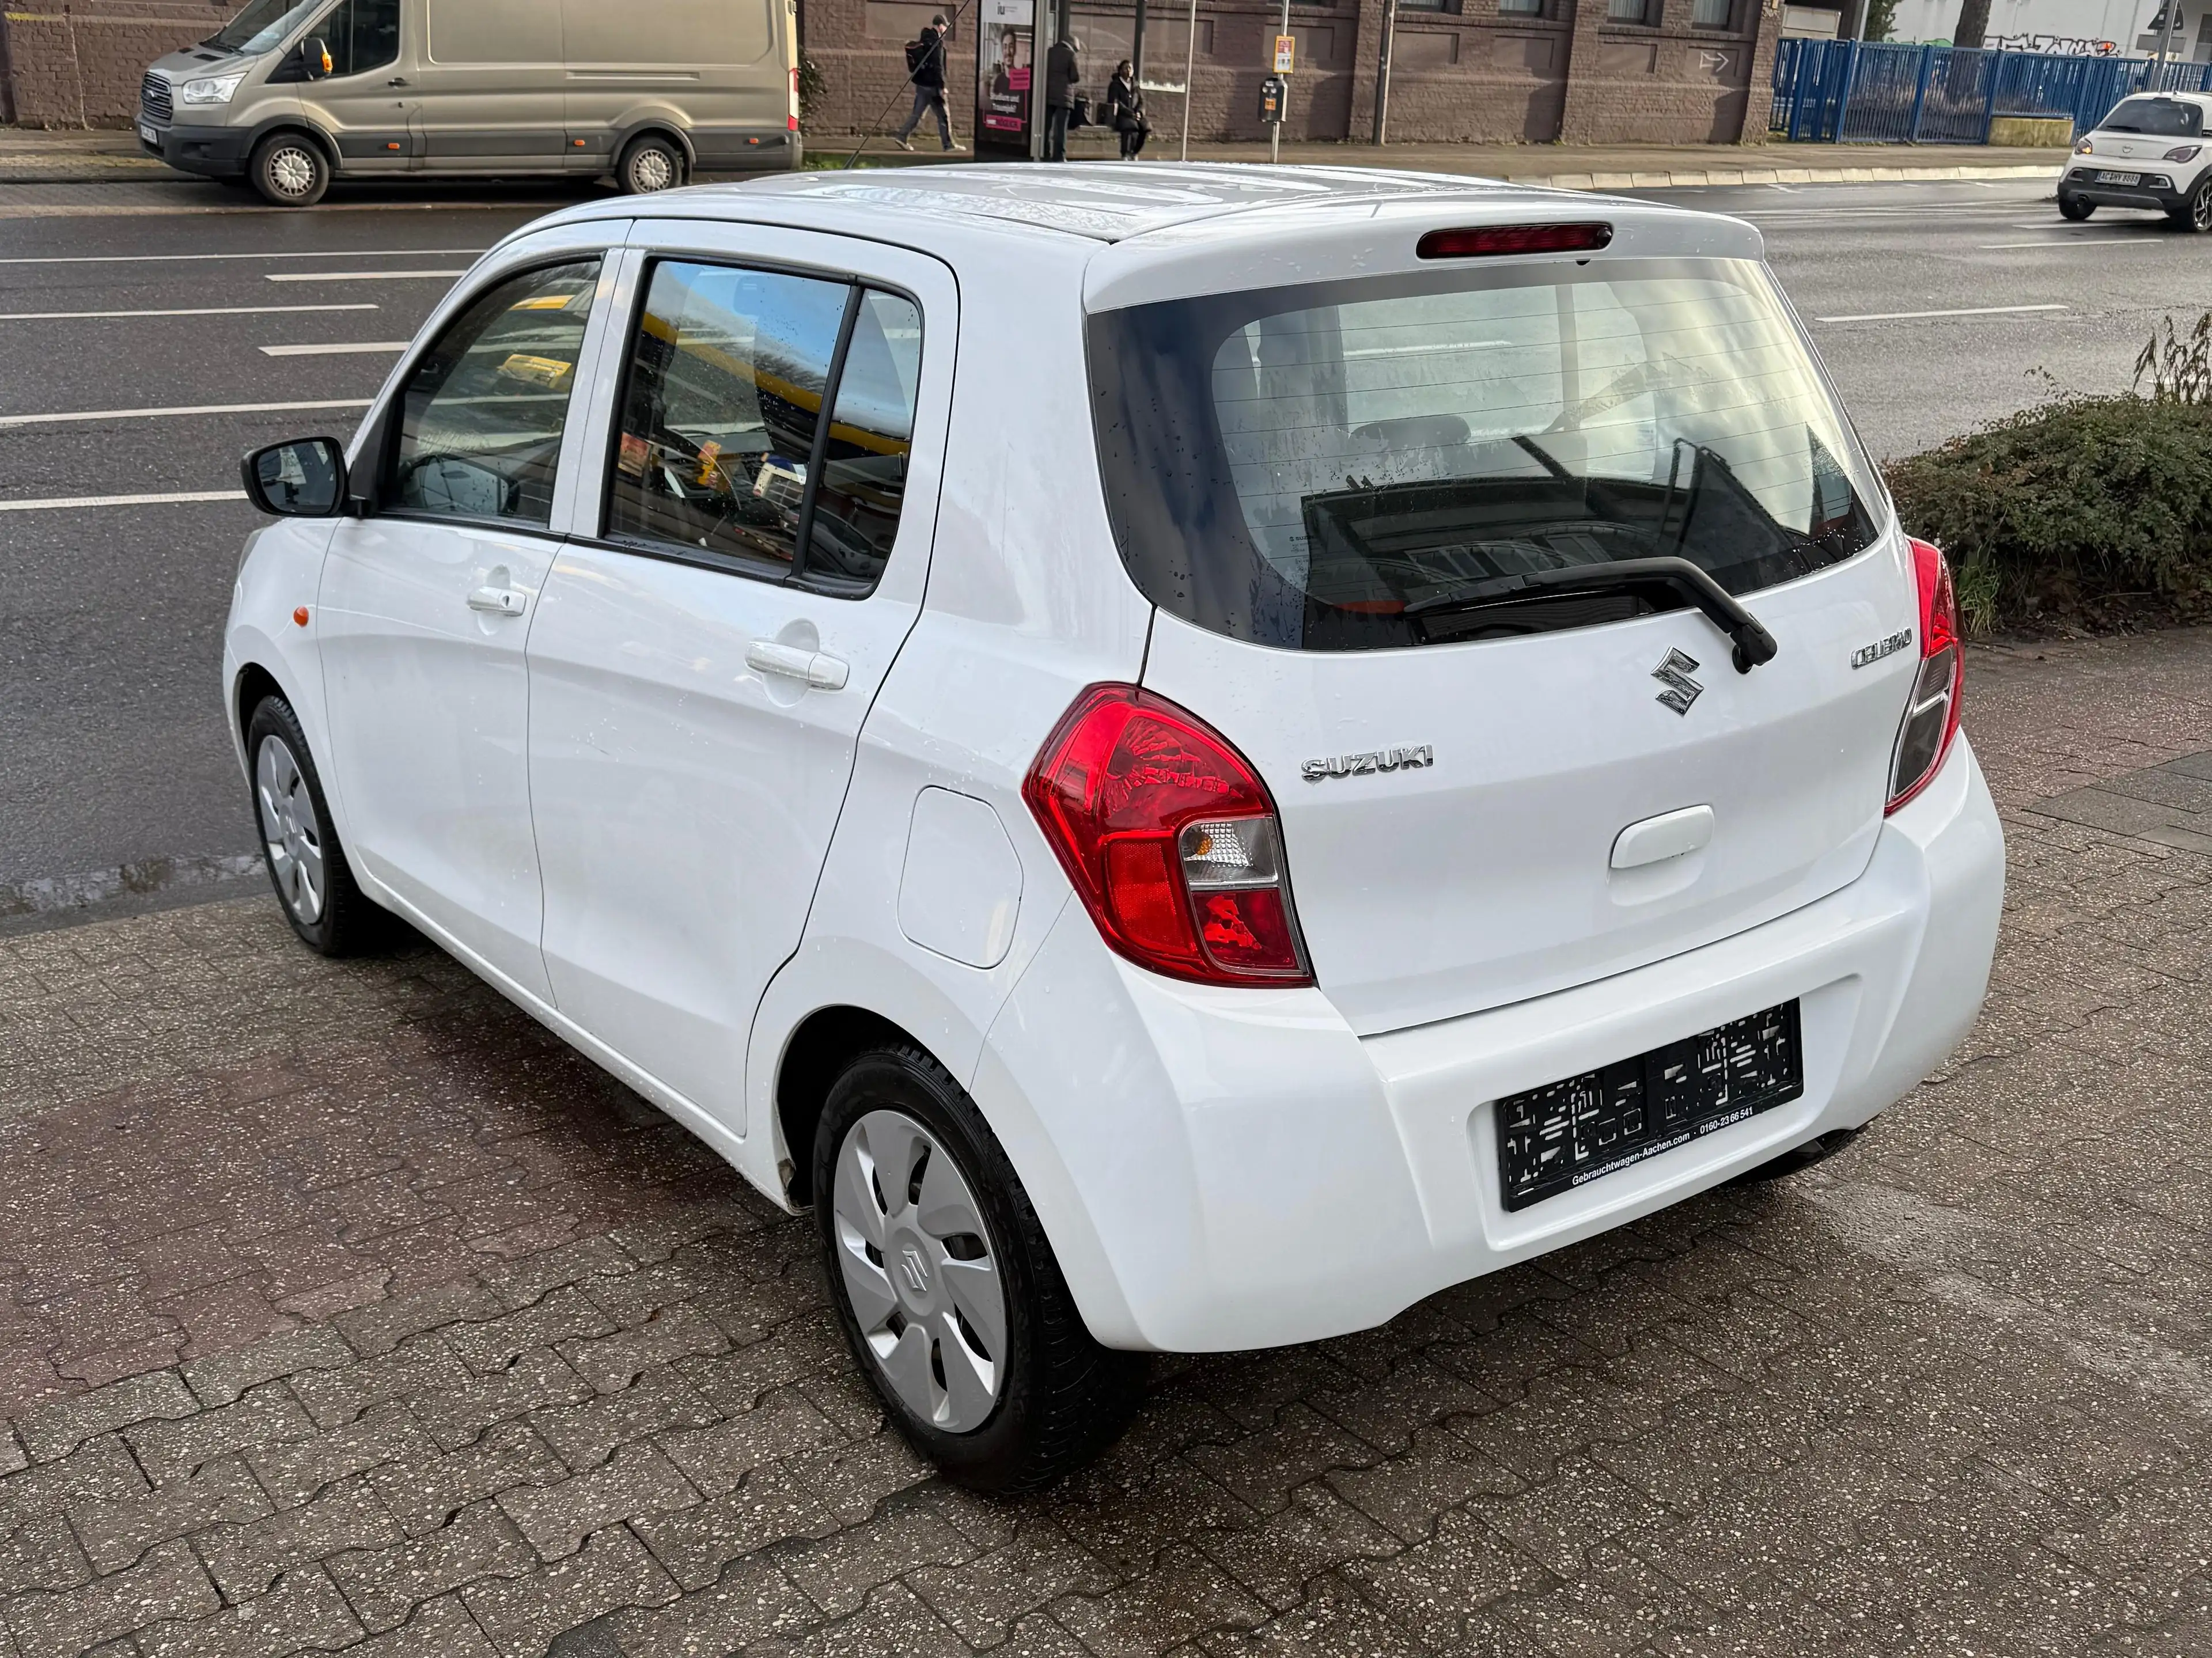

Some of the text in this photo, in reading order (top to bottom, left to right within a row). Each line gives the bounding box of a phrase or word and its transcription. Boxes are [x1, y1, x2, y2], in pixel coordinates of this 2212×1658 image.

[1301, 744, 1433, 781] SUZUKI
[1572, 1106, 1753, 1185] Gebrauchtwagen-Aachen.com 0160-23 66 541
